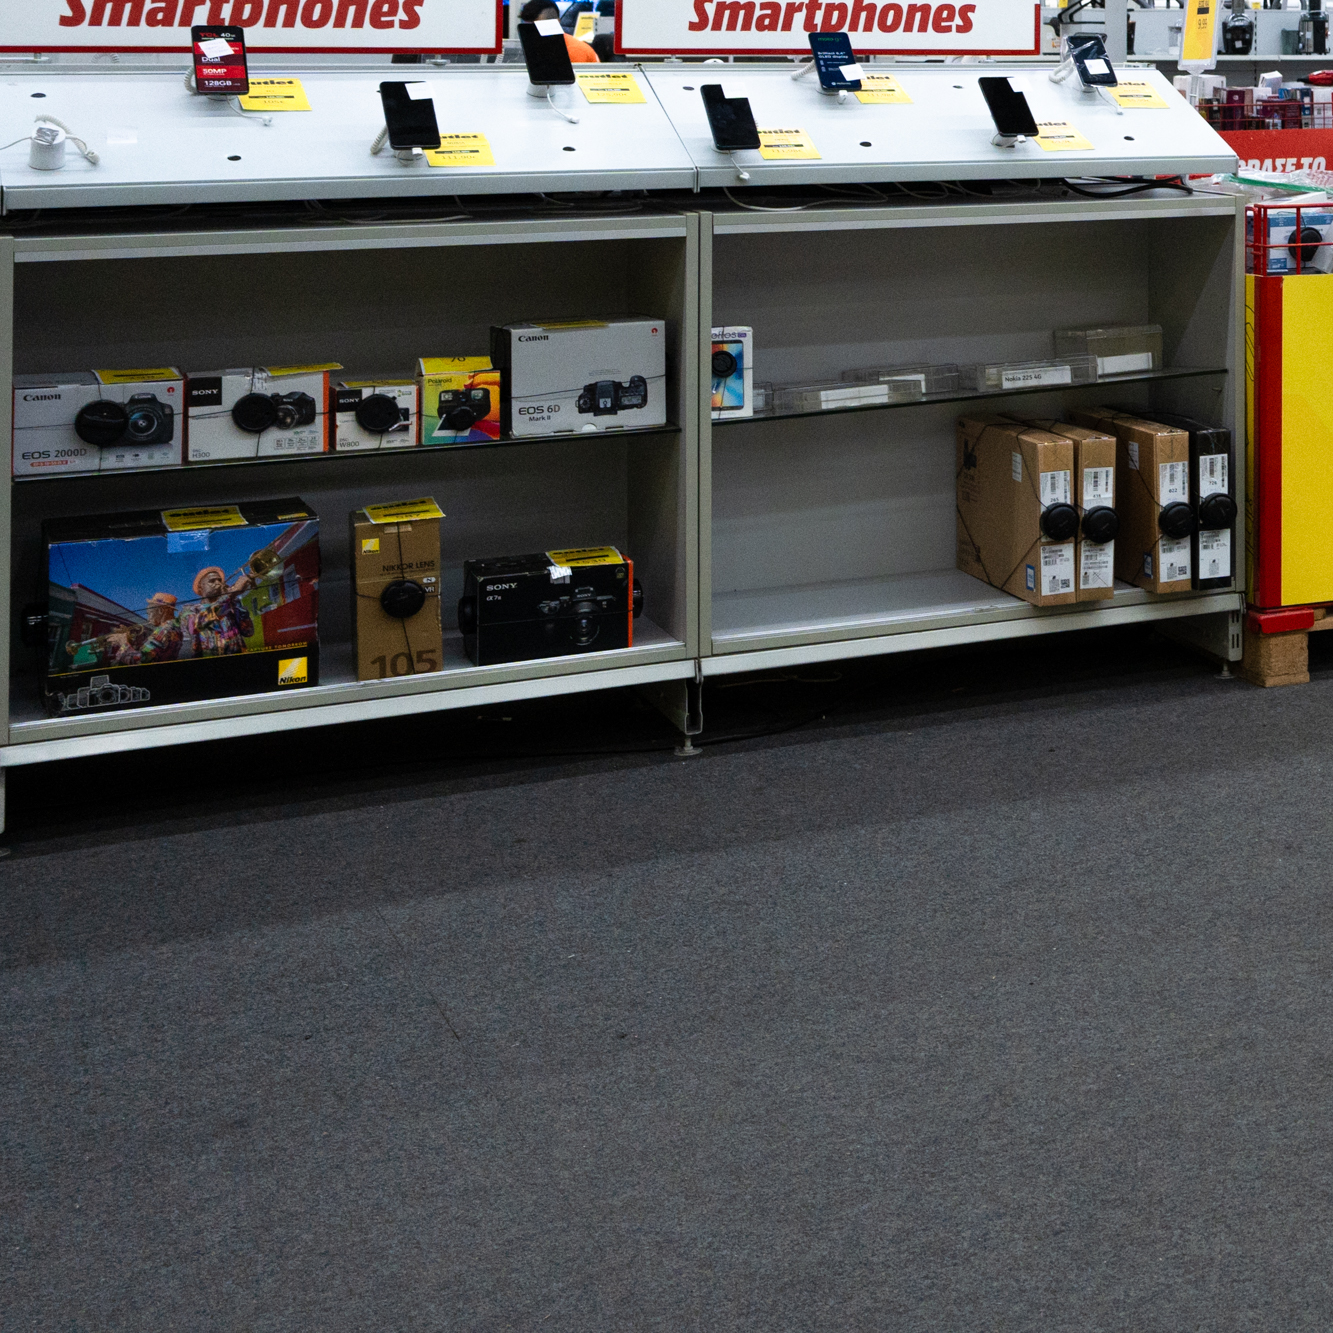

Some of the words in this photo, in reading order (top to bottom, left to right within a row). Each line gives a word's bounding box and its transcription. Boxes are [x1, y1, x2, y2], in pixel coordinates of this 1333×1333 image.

[518, 334, 549, 343] Canon
[1004, 375, 1021, 383] Nokia
[23, 393, 62, 402] Canon
[518, 406, 545, 415] EOS
[547, 404, 560, 414] 6D
[339, 440, 360, 448] W800
[21, 451, 51, 460] EOS
[54, 448, 87, 458] 2000D
[382, 562, 414, 572] NIKKOR
[416, 560, 435, 569] LENS
[486, 582, 518, 591] SONY
[370, 649, 438, 678] 105
[280, 676, 307, 684] Nikon
